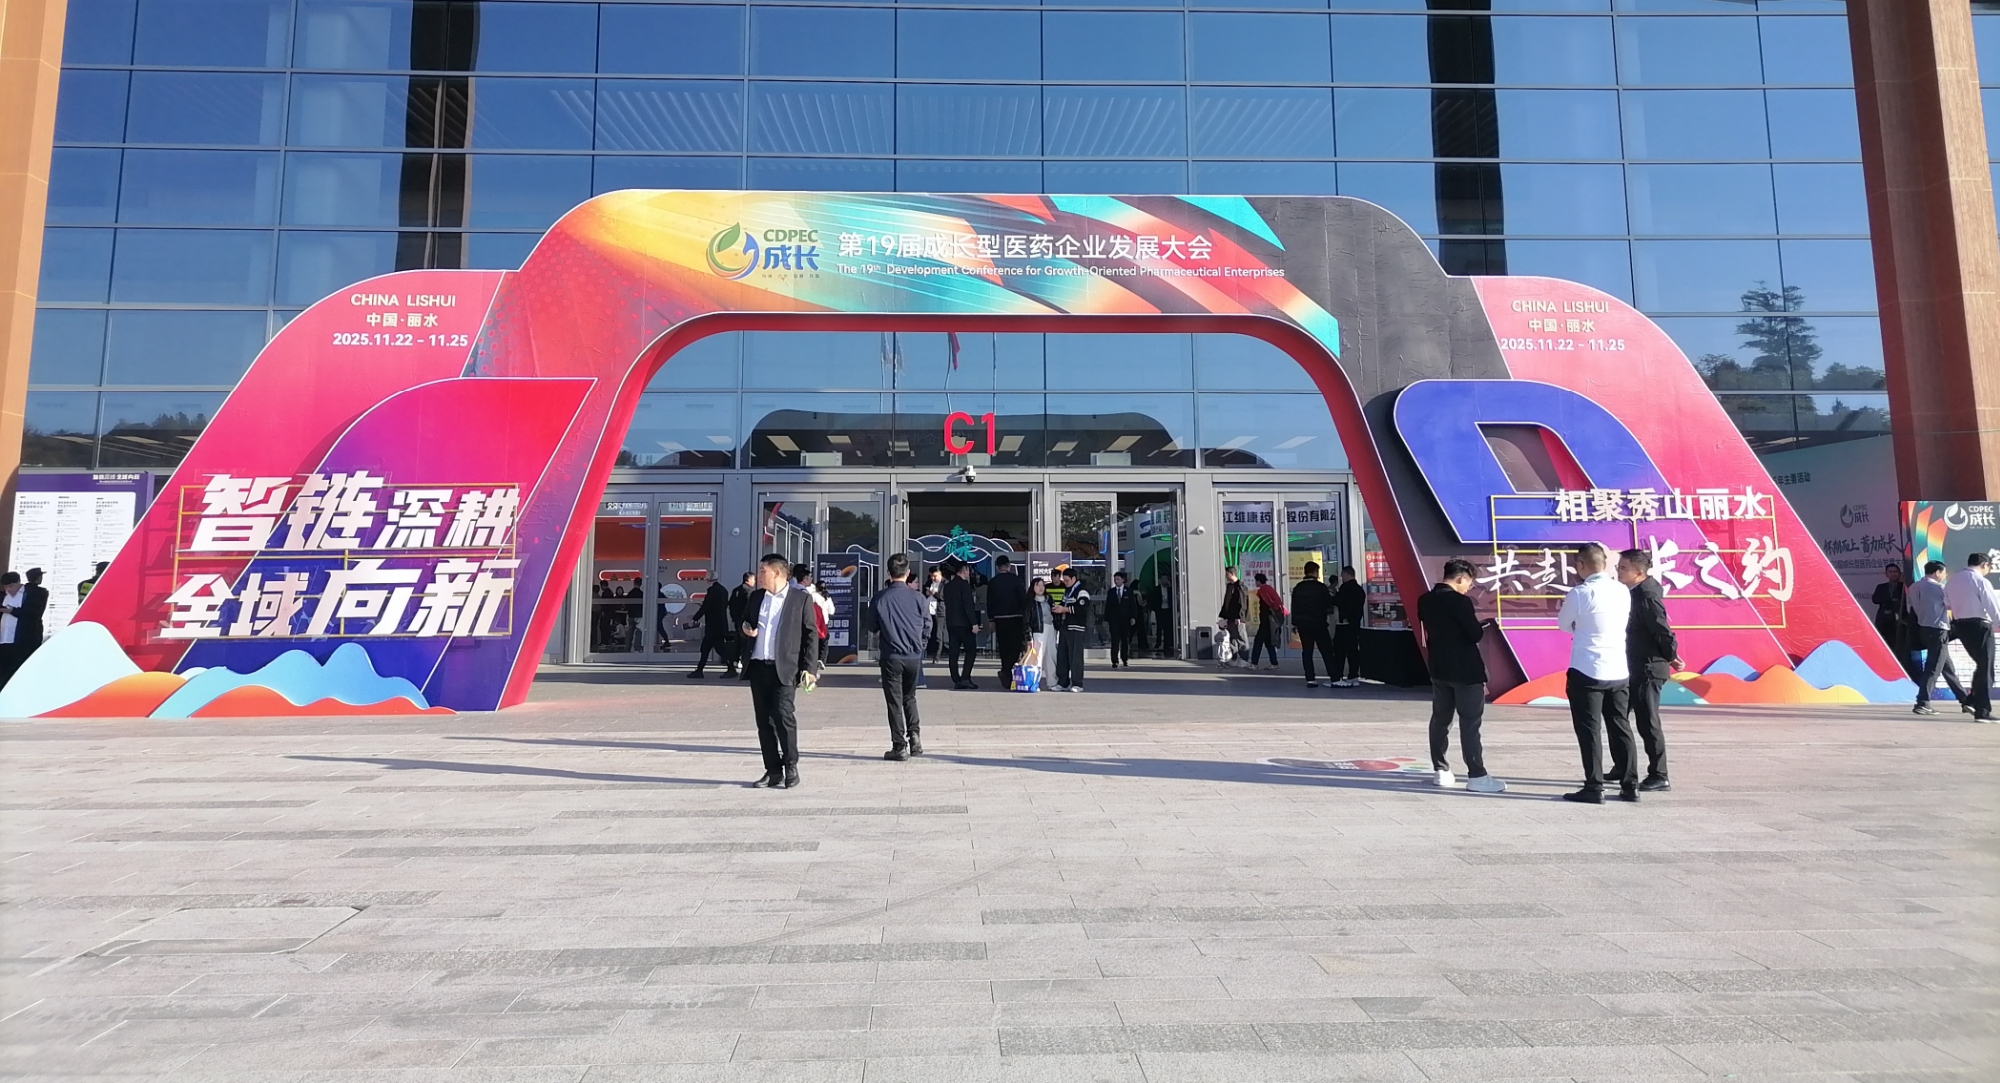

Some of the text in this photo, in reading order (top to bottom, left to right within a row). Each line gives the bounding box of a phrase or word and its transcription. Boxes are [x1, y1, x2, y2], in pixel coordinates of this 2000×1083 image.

[763, 229, 818, 242] CDPEC
[838, 231, 1212, 260] 第19届成长型医药企业发展大会
[763, 244, 819, 271] 成长
[837, 264, 857, 274] The
[886, 264, 959, 277] Development
[961, 265, 1022, 276] Conference
[1025, 265, 1041, 276] for
[1043, 266, 1136, 277] Growth-Oriented
[1140, 267, 1221, 278] Pharmaceutical
[1225, 267, 1285, 279] Enterprises
[351, 294, 456, 307] CHINA LISHUI
[1511, 300, 1609, 313] CHINA LISHUI
[366, 312, 439, 328] 中国·丽水
[1528, 318, 1595, 333] 中国·丽水
[332, 333, 413, 346] 2025.11.22
[429, 335, 469, 347] 11.25
[1500, 338, 1574, 351] 2025.11.22
[1588, 339, 1625, 351] 11.25
[943, 411, 996, 455] C1
[190, 470, 520, 550] 智链深耕
[1555, 486, 1767, 522] 相聚秀山丽水
[1968, 505, 1994, 513] CDPEC
[1854, 511, 1870, 523] 成长
[1969, 512, 1996, 526] 成长
[1477, 535, 1793, 601] 共赴长之约
[159, 558, 521, 637] 全域向新
